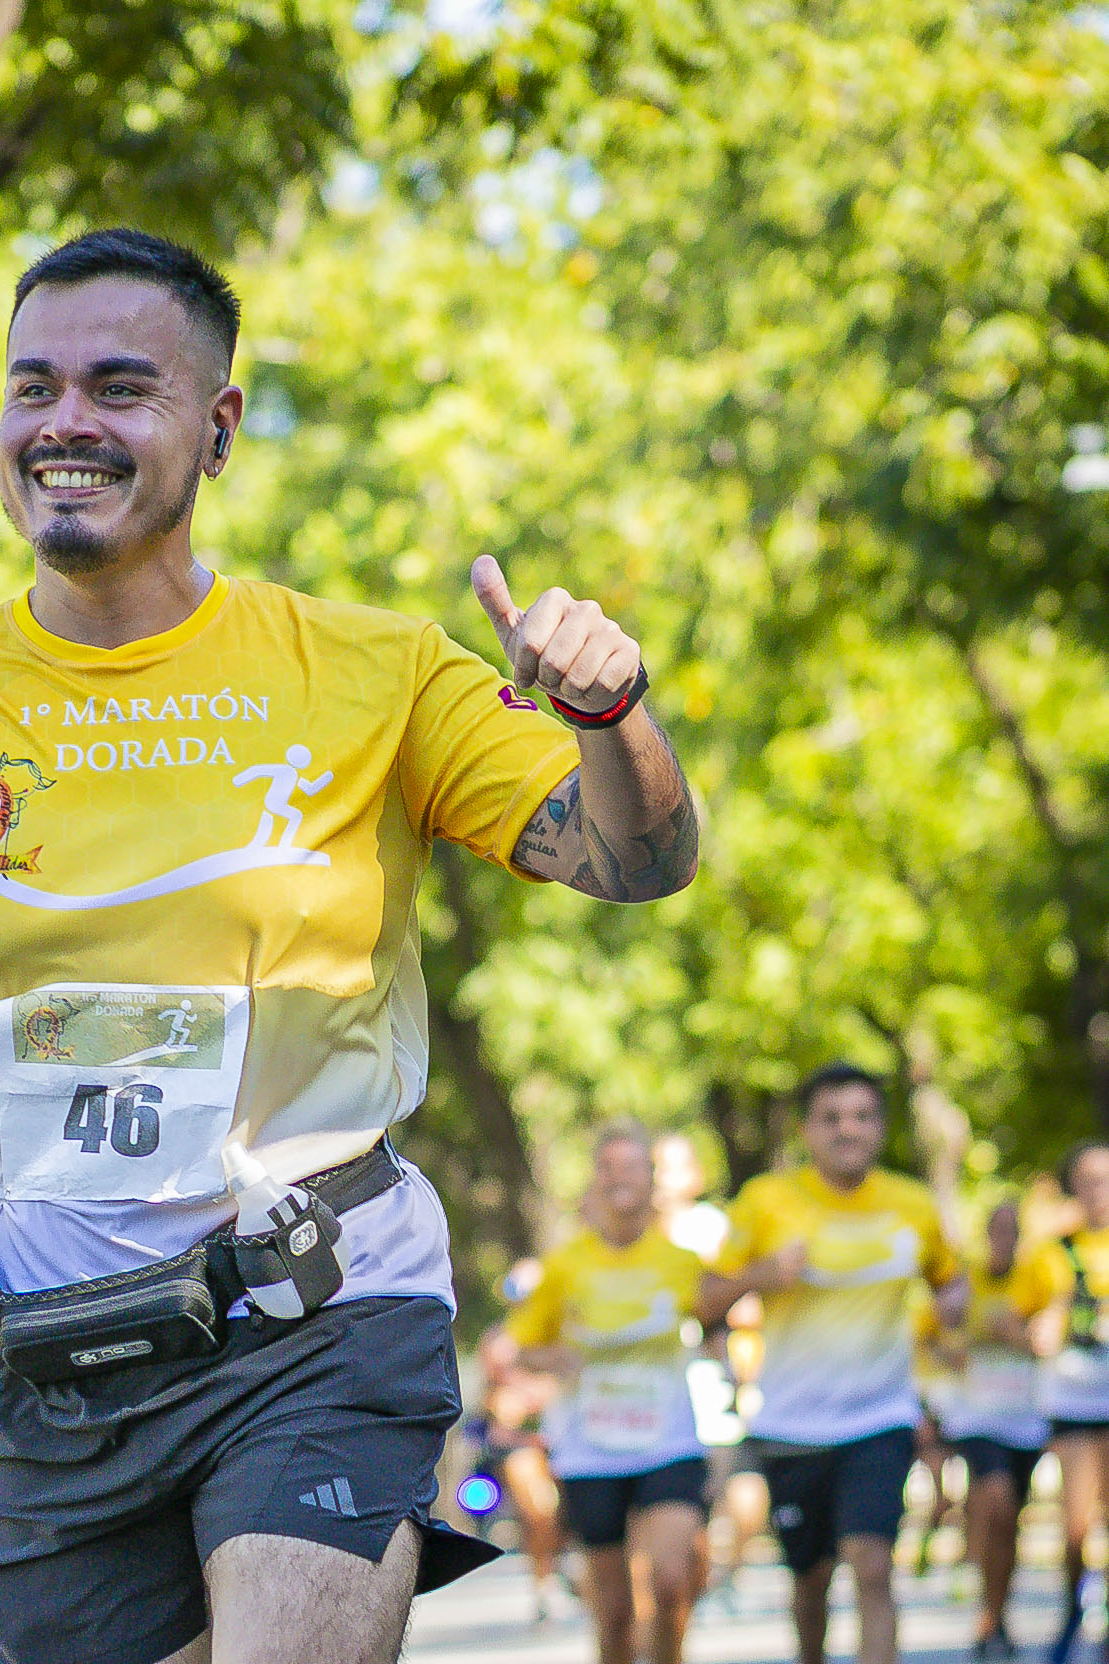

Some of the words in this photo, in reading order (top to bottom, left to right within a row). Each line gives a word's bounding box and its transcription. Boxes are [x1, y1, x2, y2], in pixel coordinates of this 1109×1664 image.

[61, 688, 270, 726] MARATÓN
[54, 736, 236, 772] DORADA
[63, 1083, 164, 1158] 46
